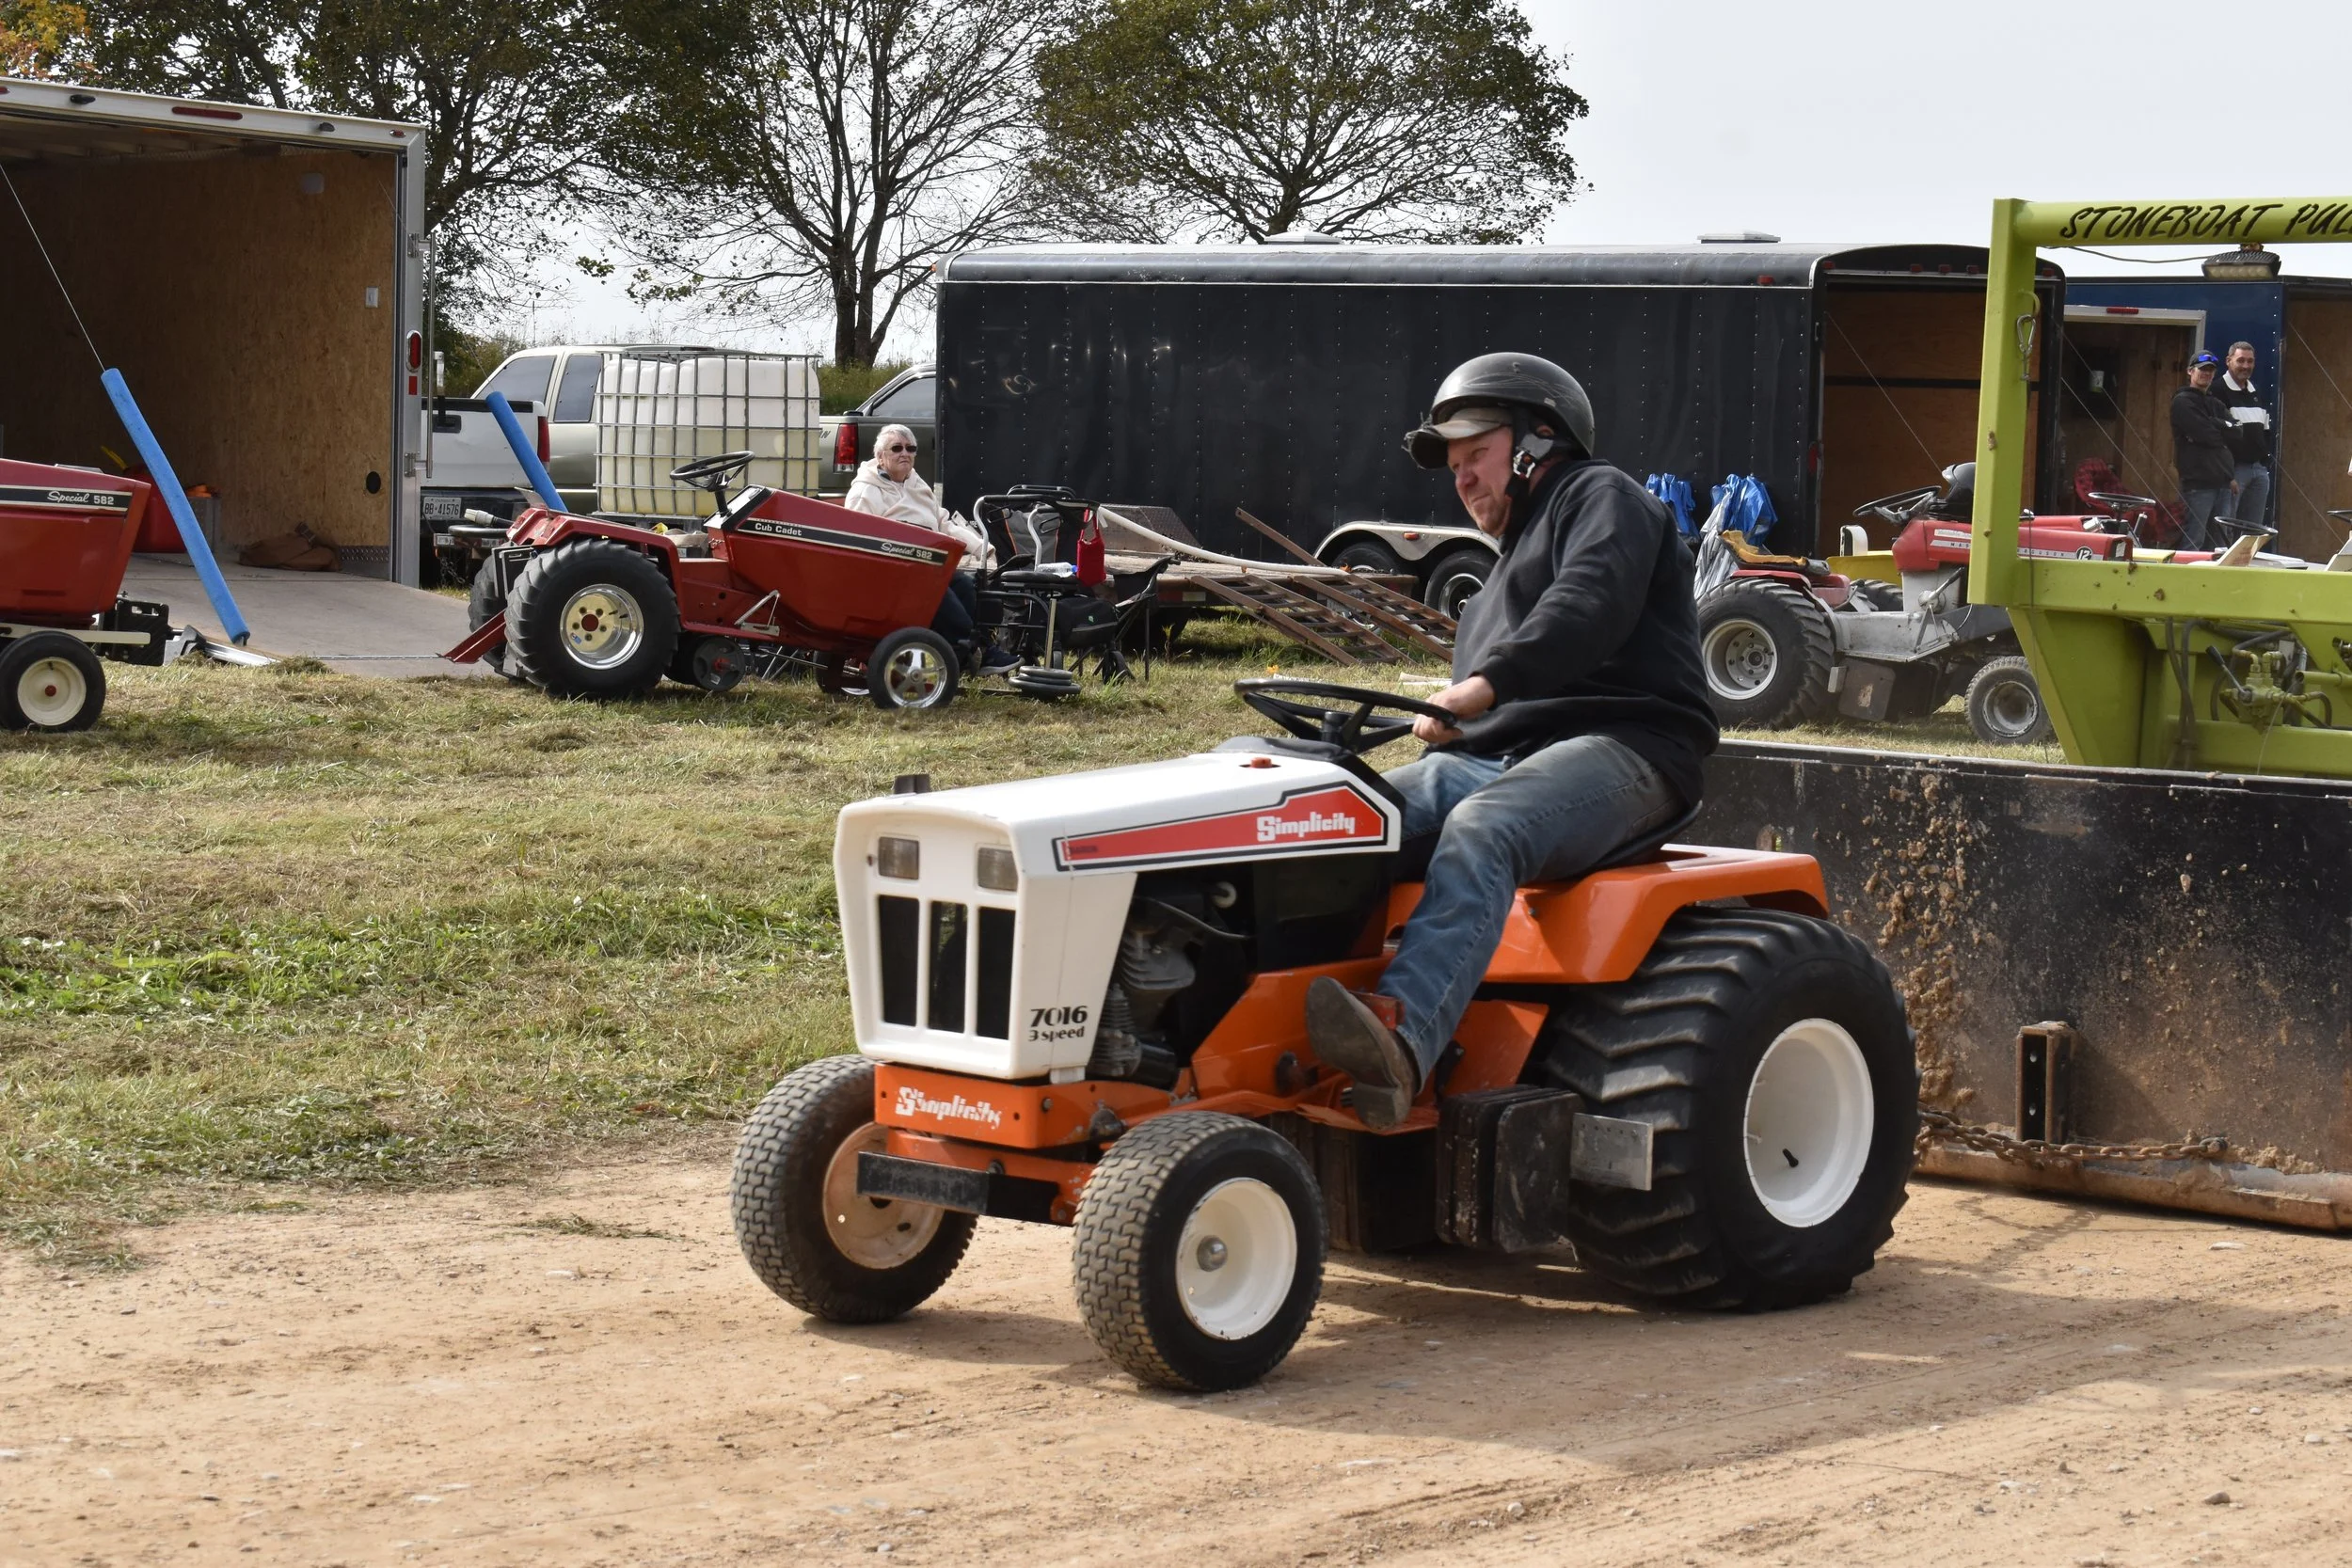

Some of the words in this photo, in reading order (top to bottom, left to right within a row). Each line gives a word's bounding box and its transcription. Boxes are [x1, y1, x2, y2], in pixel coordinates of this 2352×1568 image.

[2059, 204, 2284, 238] STONEBOAT
[2284, 203, 2352, 235] PUL
[47, 490, 89, 503] Special
[94, 495, 114, 505] 582
[755, 522, 772, 532] Cub
[775, 525, 803, 536] Cadet
[881, 542, 915, 556] Special
[915, 549, 933, 561] 582
[2078, 548, 2092, 561] 12
[1256, 811, 1356, 842] Simplicity
[1030, 1005, 1089, 1028] 7016
[1027, 1029, 1040, 1042] 3
[1041, 1025, 1086, 1043] speed
[895, 1085, 1003, 1130] Simplicity
